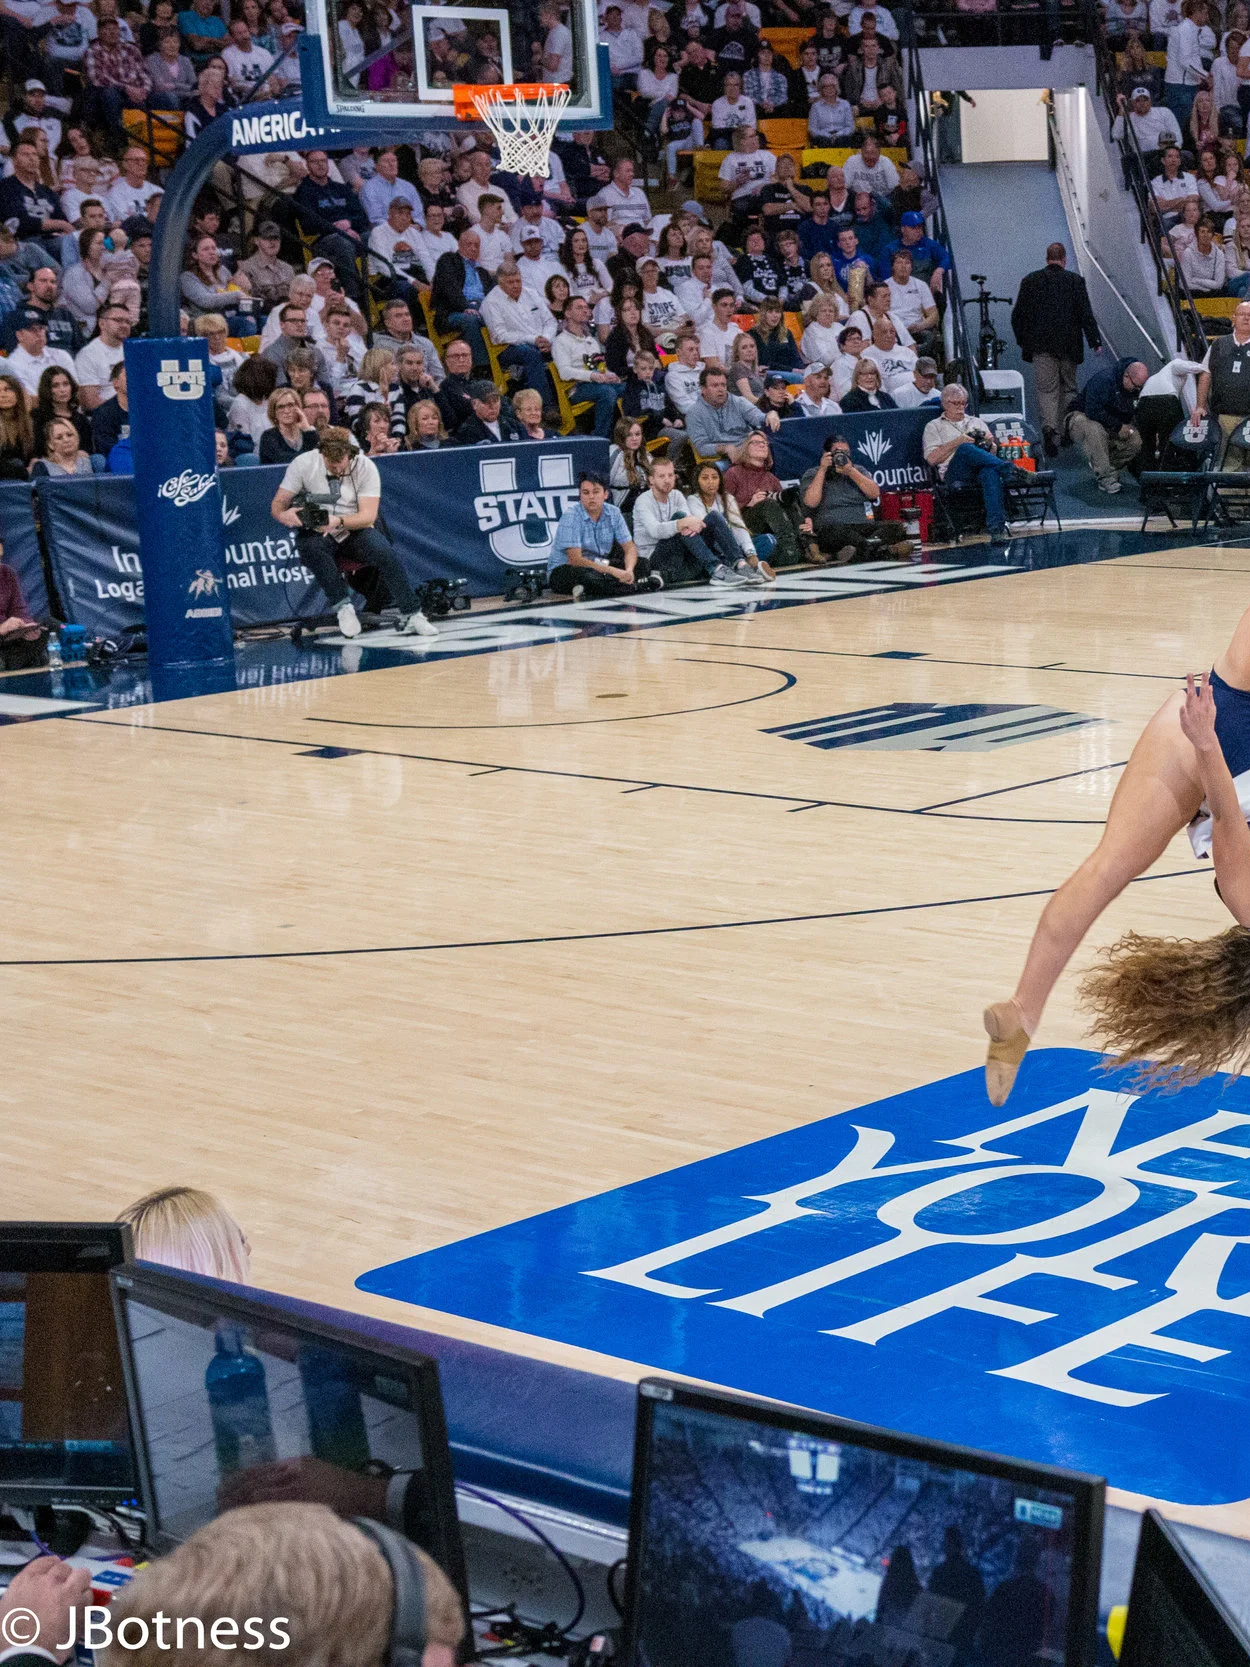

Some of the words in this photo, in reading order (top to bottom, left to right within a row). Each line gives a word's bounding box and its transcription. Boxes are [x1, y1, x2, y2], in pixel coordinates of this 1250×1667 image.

[474, 488, 581, 532] STATE
[95, 578, 145, 601] Loga
[262, 563, 317, 585] Hosp
